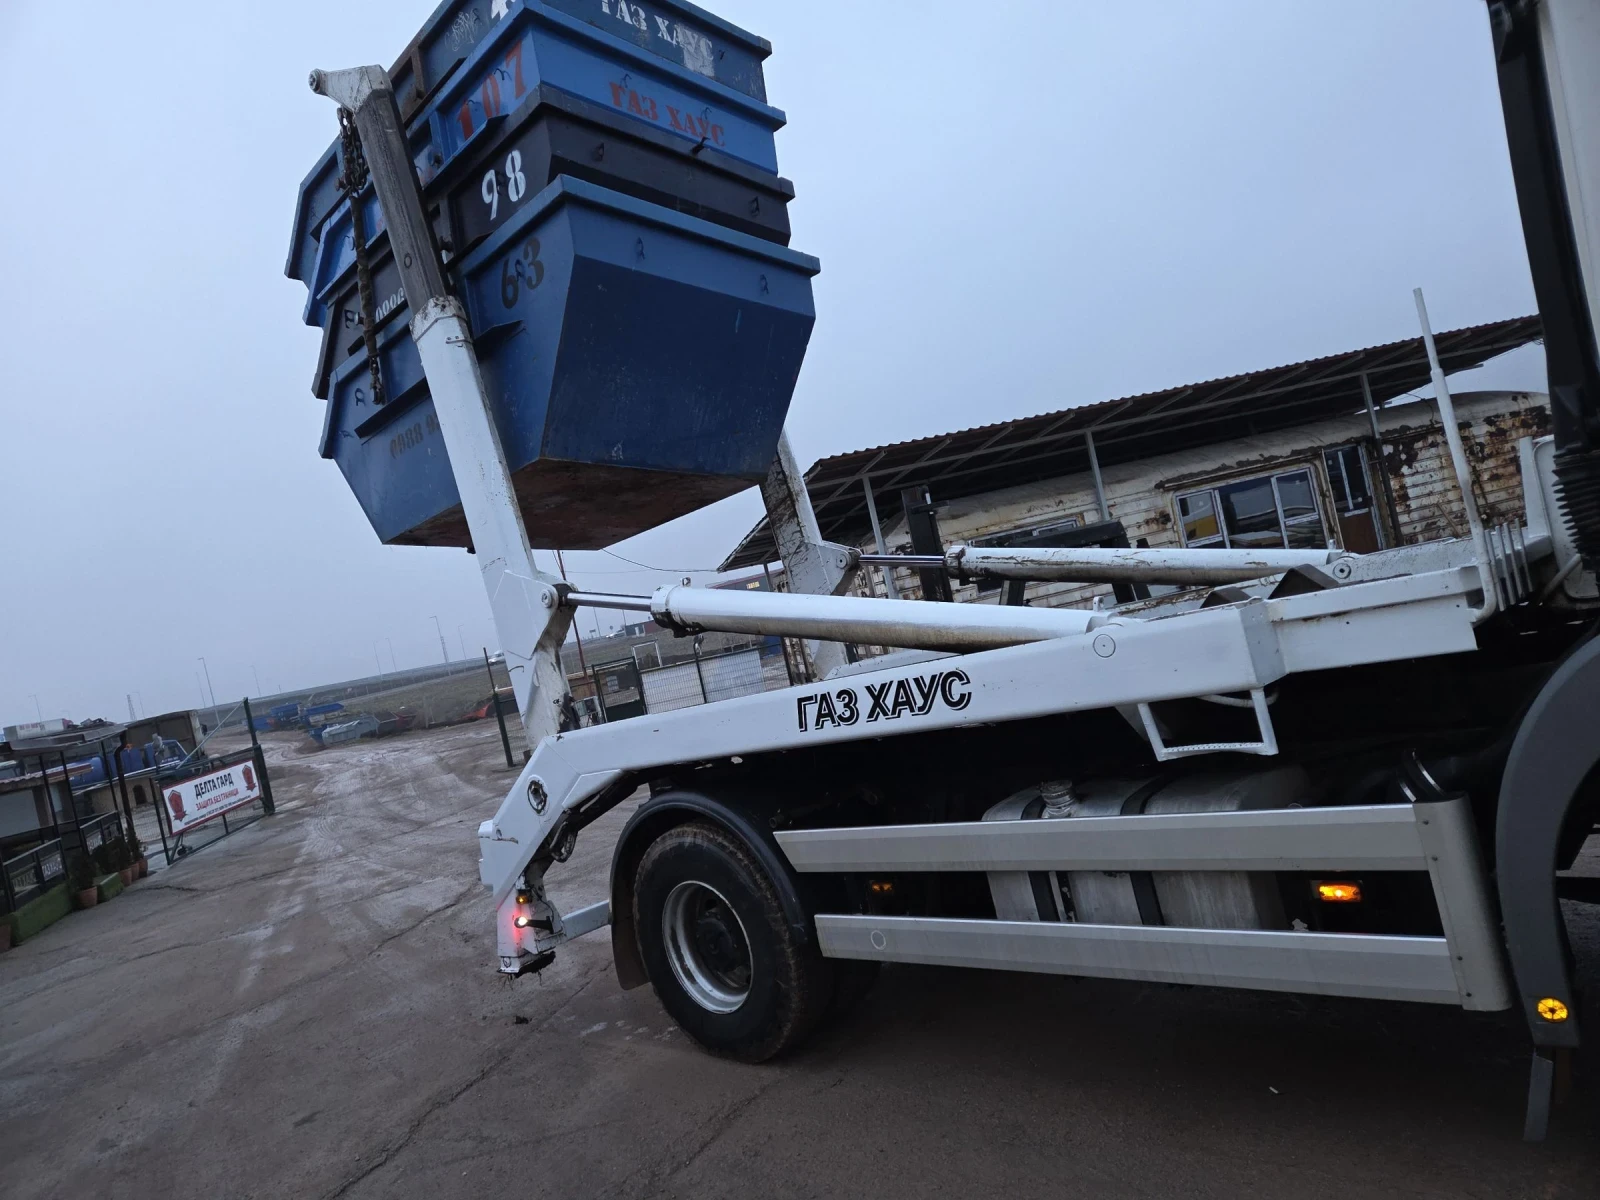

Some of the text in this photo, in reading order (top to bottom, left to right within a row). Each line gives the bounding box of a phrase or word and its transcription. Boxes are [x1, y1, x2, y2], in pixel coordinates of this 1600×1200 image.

[601, 0, 648, 31] ГАЗ
[456, 39, 526, 141] 107
[608, 81, 726, 147] ГАЗ ХАУС
[482, 150, 526, 221] 98
[501, 236, 545, 309] 63
[796, 669, 972, 732] ГАЗ ХАУС
[194, 773, 234, 800] ДЕЛТА ГАРД
